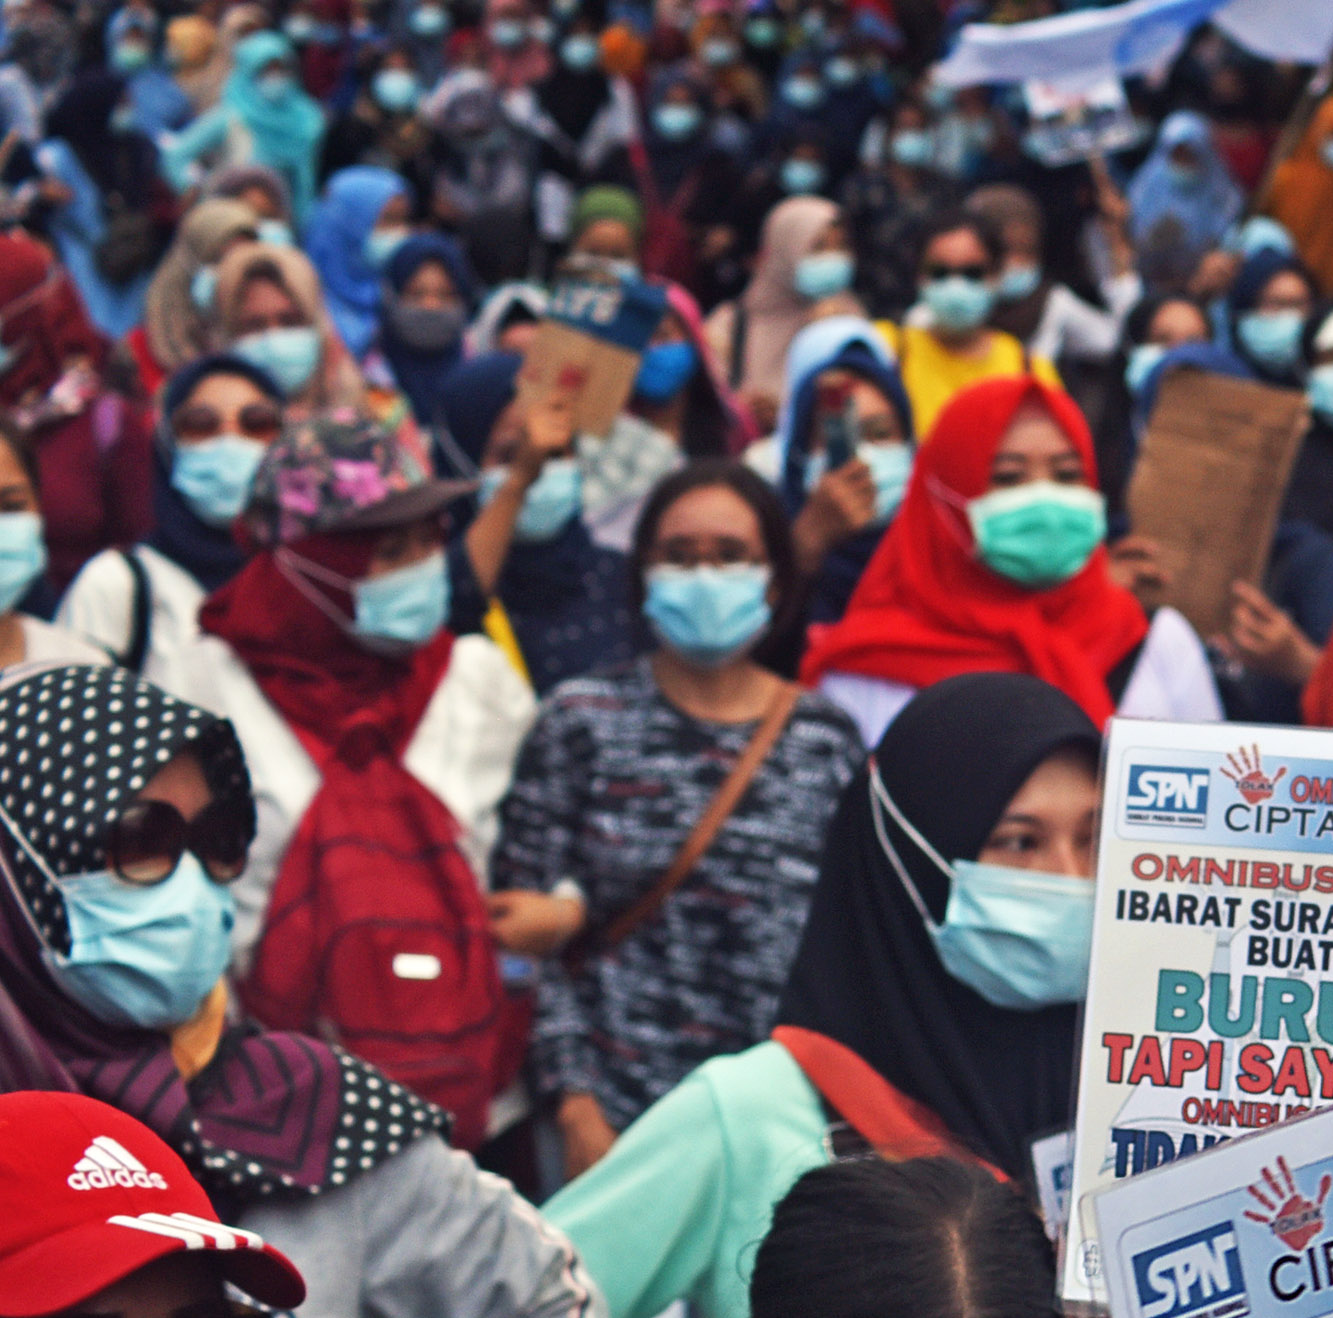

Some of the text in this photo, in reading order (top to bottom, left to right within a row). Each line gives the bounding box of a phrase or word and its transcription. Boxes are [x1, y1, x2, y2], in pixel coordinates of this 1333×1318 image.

[1127, 770, 1209, 809] SPN
[1116, 889, 1242, 927] IBARAT
[1102, 1033, 1224, 1090] TAPI
[67, 1171, 168, 1191] adidas
[1142, 1231, 1238, 1318] SPN
